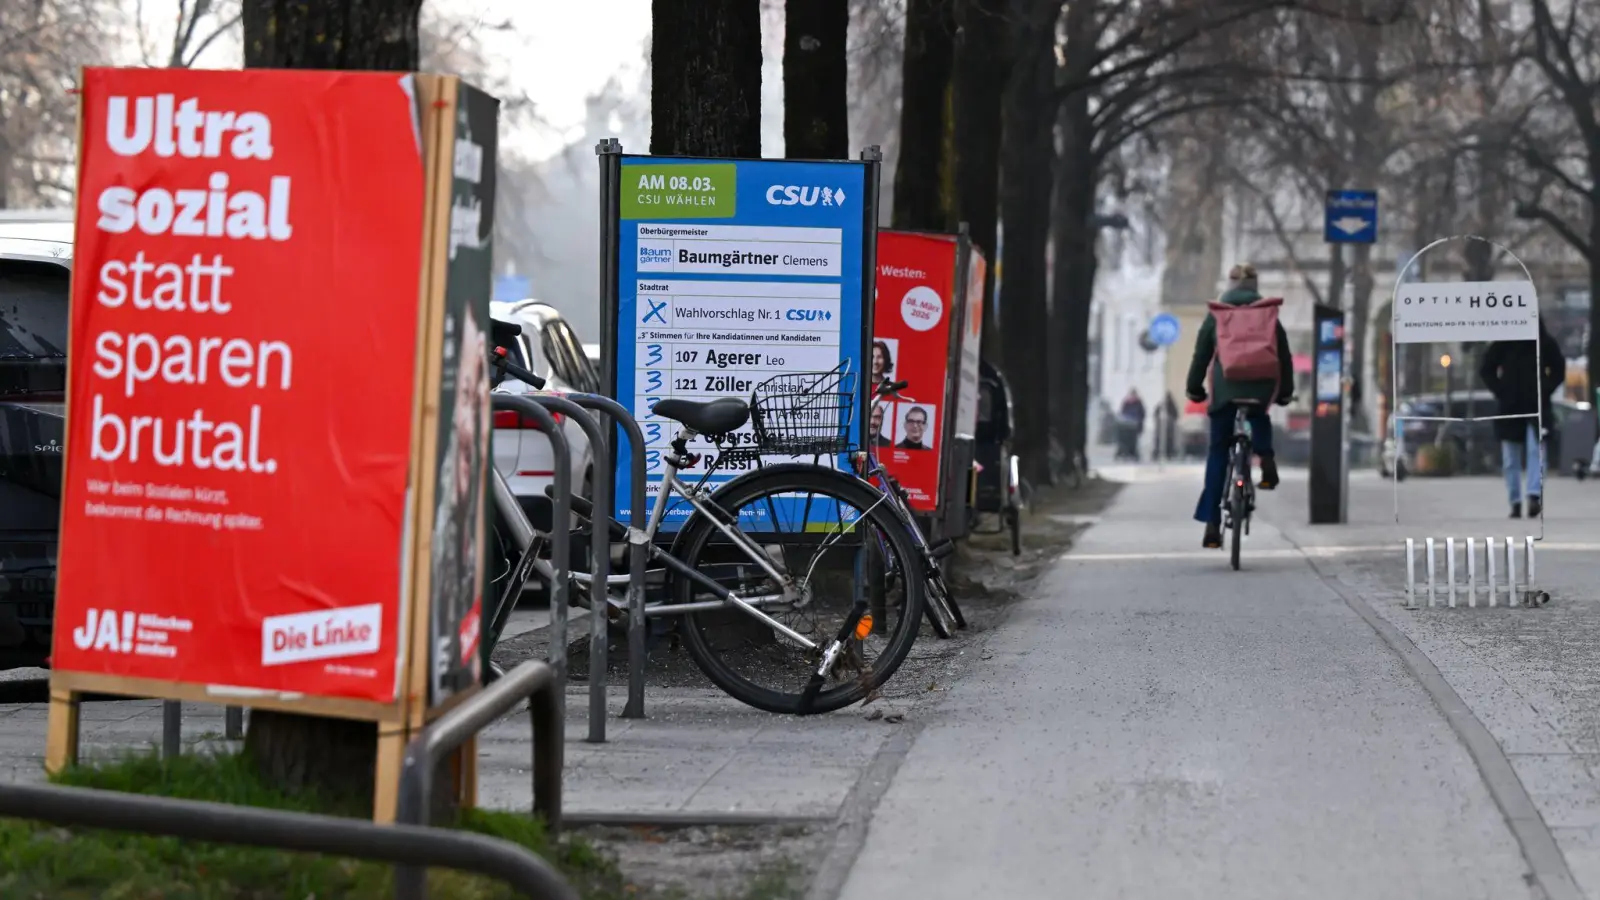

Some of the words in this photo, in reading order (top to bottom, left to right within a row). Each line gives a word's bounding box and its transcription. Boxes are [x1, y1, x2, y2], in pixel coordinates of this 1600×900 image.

[106, 93, 273, 161] Ultra
[638, 175, 665, 190] AM
[669, 176, 716, 191] 08.03.
[637, 194, 661, 204] CSU
[666, 194, 716, 206] WÄHLEN
[766, 185, 821, 206] CSU
[96, 171, 293, 241] sozial
[640, 227, 708, 238] Oberbürgermeister
[678, 249, 779, 267] Baumgärtner
[782, 255, 828, 267] Clemens
[881, 265, 926, 279] Westen:
[97, 251, 234, 314] statt
[639, 283, 669, 292] Stadtrat
[906, 297, 917, 306] 08.
[920, 301, 940, 312] März
[1404, 296, 1462, 305] OPTIK
[1469, 292, 1526, 308] HÖGL
[675, 307, 755, 321] Wahlvorschlag
[757, 309, 773, 319] Nr.
[775, 311, 781, 319] 1
[786, 309, 817, 321] CSU
[911, 309, 930, 320] 2026
[650, 331, 683, 340] Stimmen
[684, 332, 694, 340] für
[696, 332, 711, 341] Ihre
[712, 333, 764, 341] Kandidatinnen
[765, 334, 779, 342] und
[781, 334, 822, 343] Kandidaten
[93, 331, 292, 397] sparen
[645, 345, 663, 367] 3
[675, 351, 698, 363] 107
[705, 350, 761, 368] Agerer
[766, 357, 785, 366] Leo
[645, 371, 663, 393] 3
[675, 378, 698, 390] 121
[705, 376, 752, 393] Zöller
[90, 393, 278, 474] brutal.
[73, 607, 136, 653] JA!
[272, 626, 307, 653] Die
[312, 617, 373, 647] Linke
